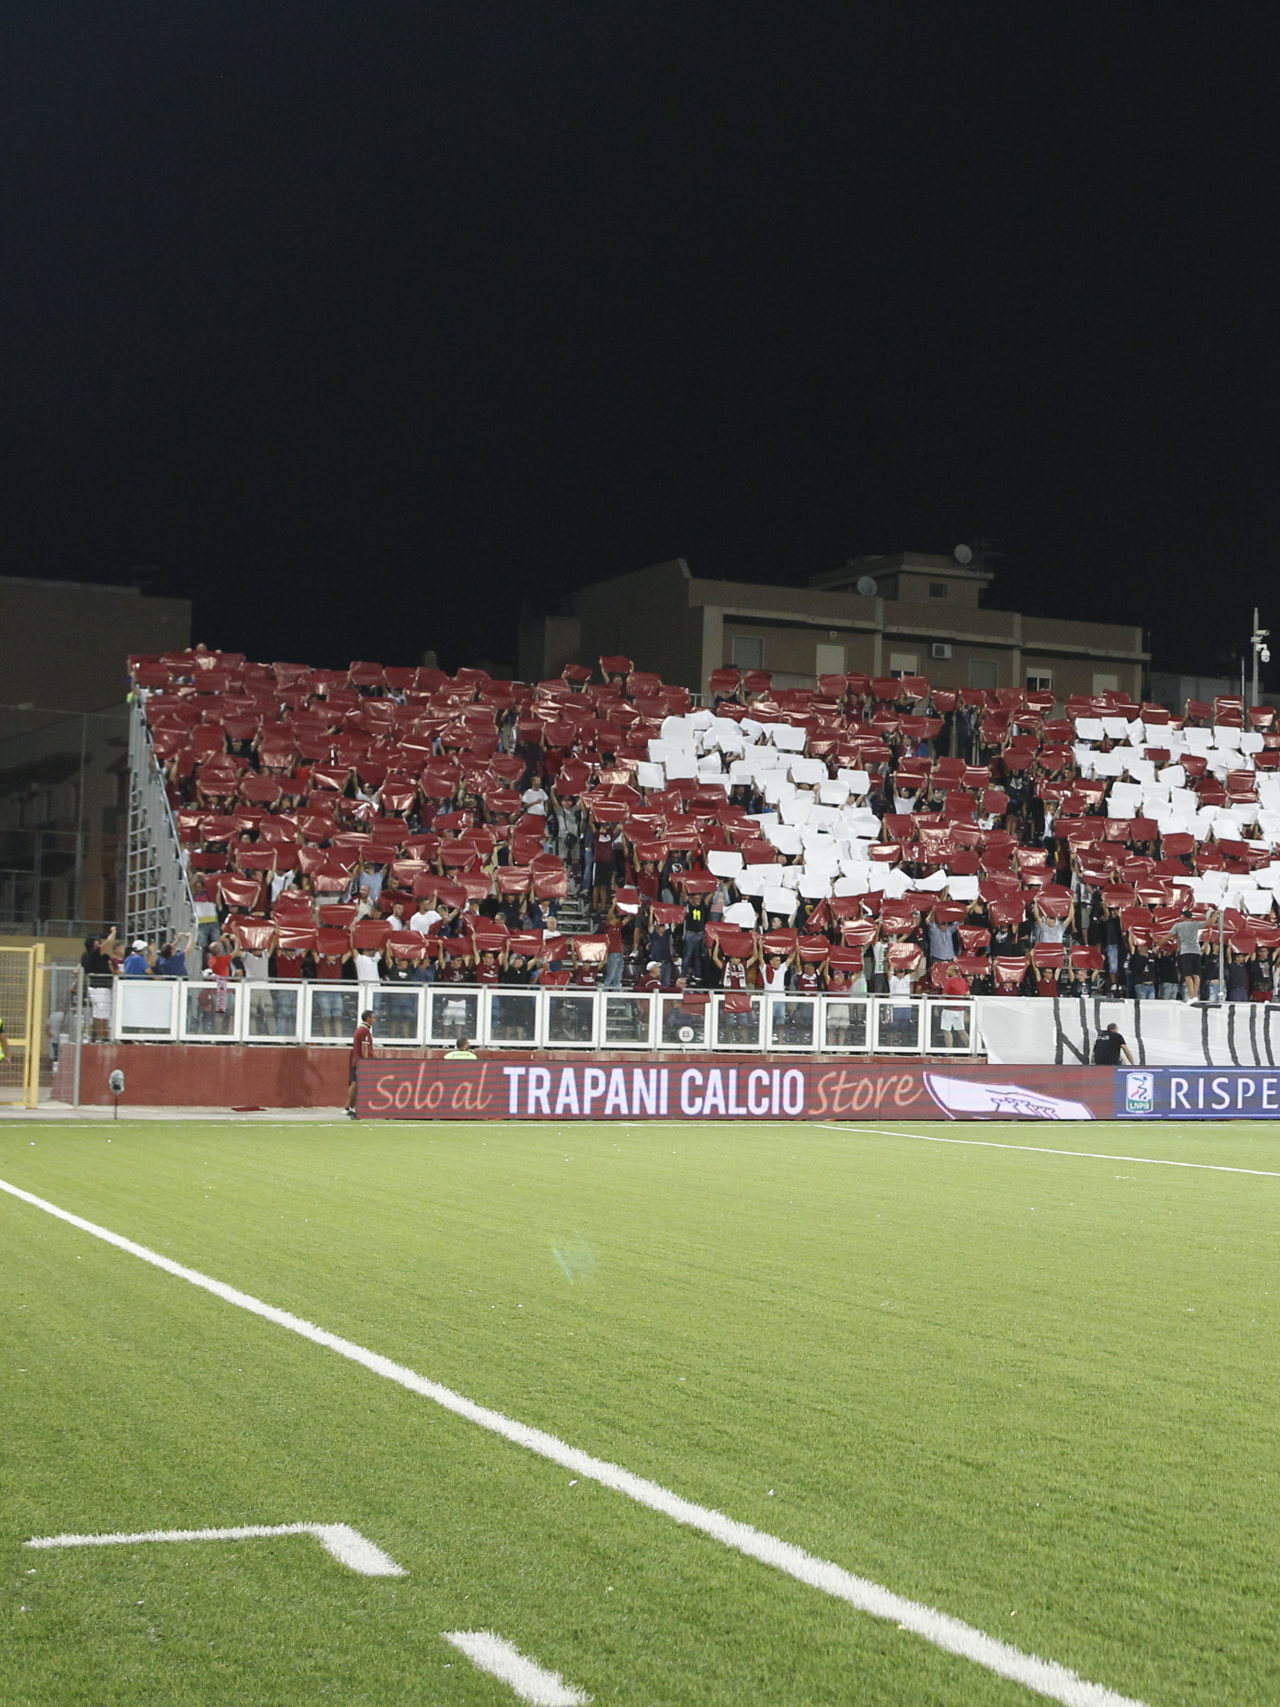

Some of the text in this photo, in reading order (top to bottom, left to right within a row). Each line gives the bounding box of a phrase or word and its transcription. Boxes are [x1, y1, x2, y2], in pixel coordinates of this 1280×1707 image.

[368, 1062, 924, 1118] Solo al TRAPANI CALCIO Store
